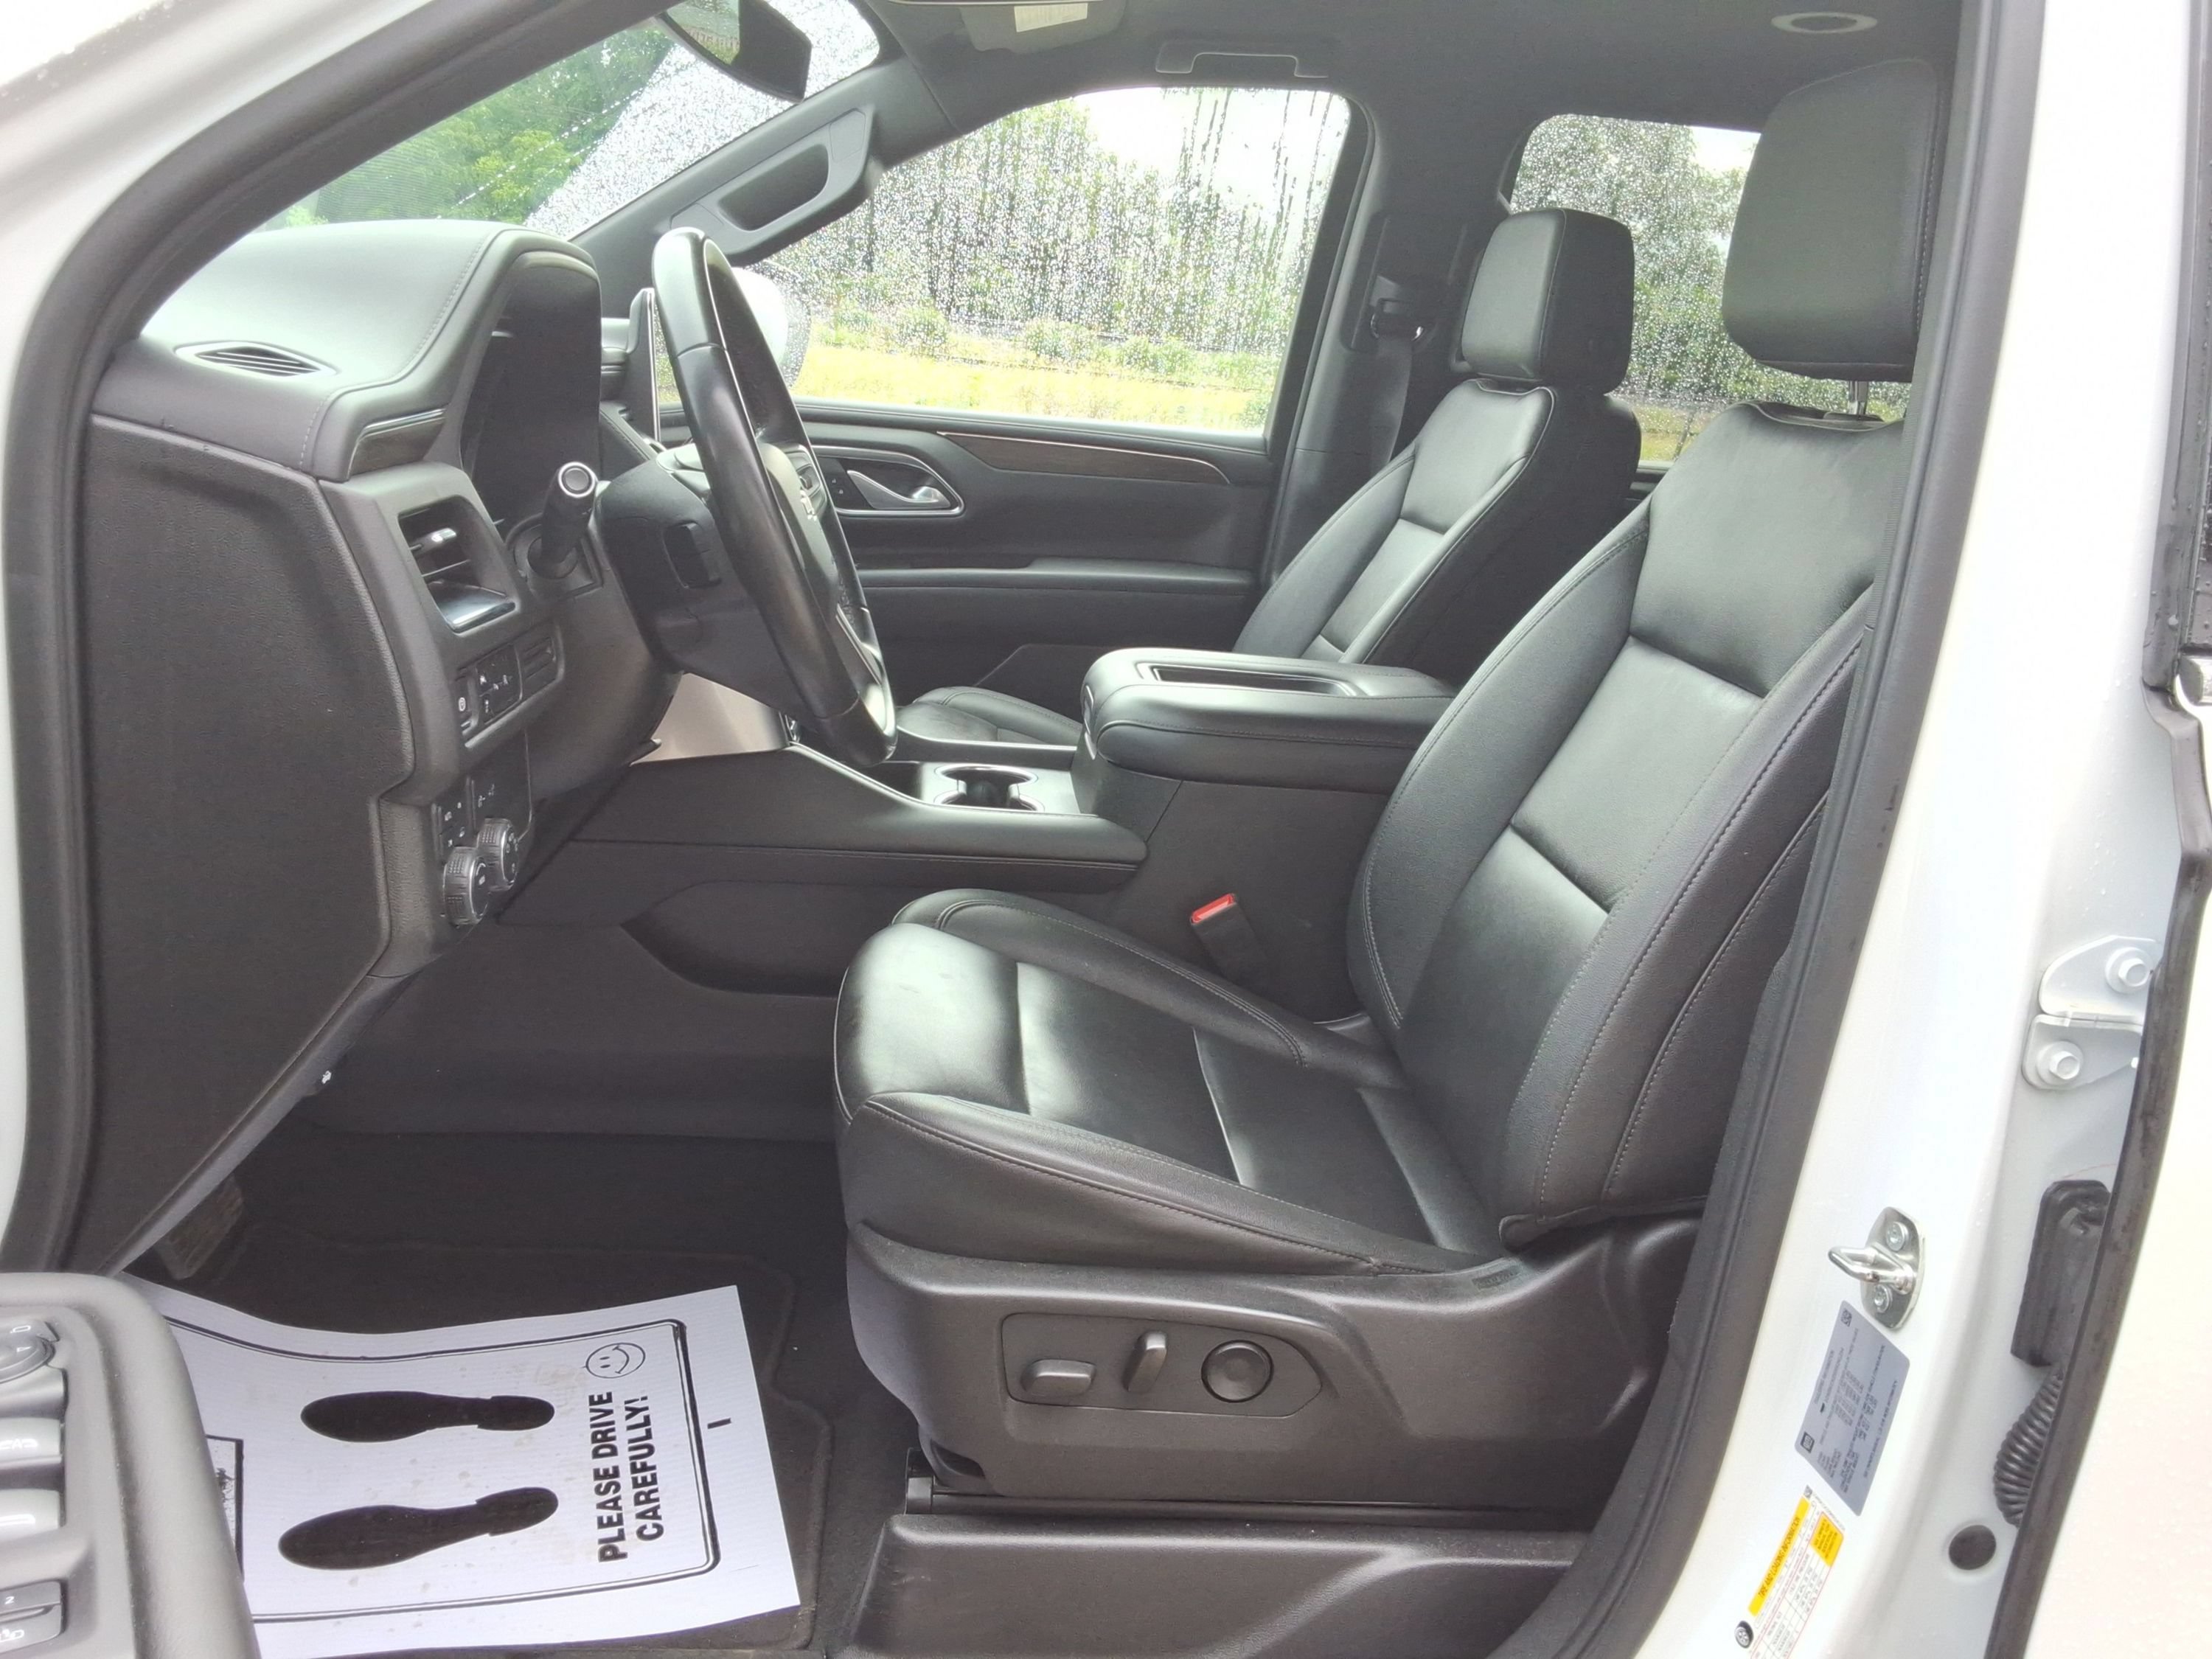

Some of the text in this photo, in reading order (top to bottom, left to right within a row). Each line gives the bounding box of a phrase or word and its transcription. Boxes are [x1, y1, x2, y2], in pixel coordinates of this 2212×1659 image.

[588, 1391, 627, 1562] PLEASE DRIVE
[624, 1396, 664, 1542] CAREFULLY!
[4, 1596, 15, 1605] 2
